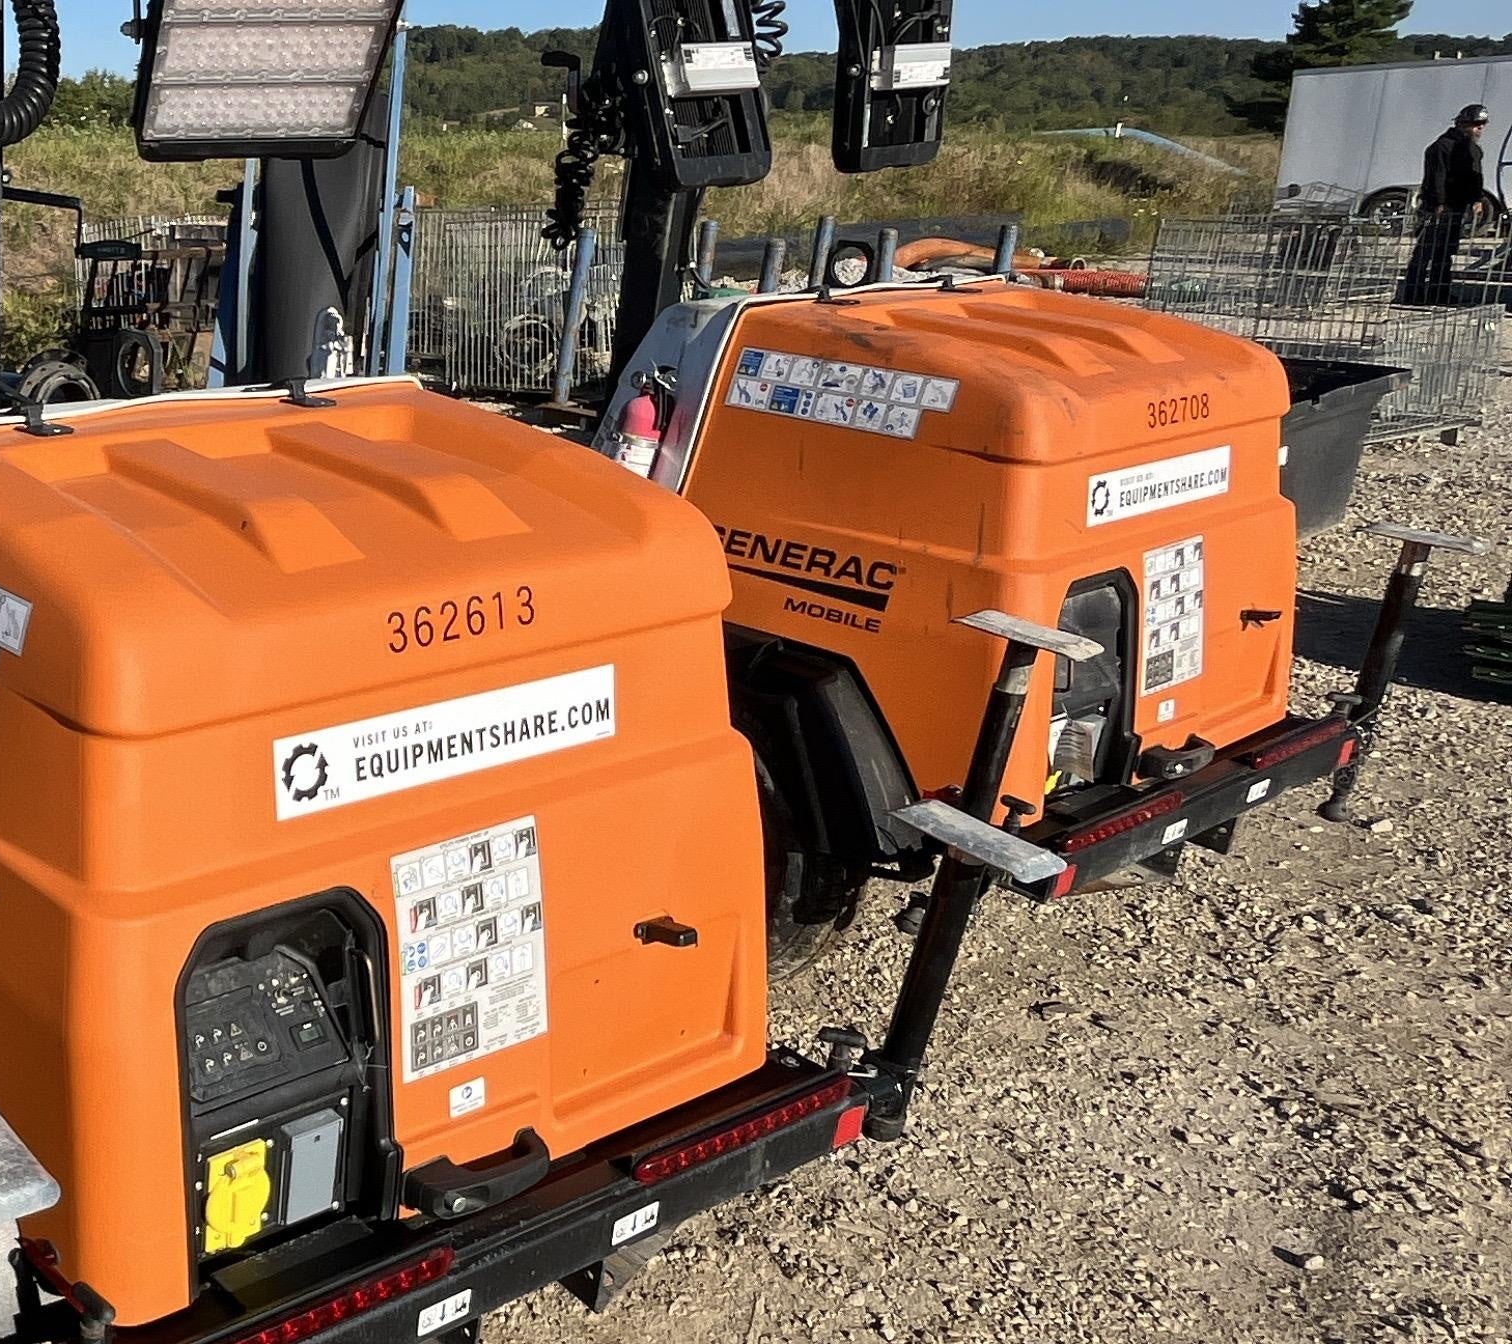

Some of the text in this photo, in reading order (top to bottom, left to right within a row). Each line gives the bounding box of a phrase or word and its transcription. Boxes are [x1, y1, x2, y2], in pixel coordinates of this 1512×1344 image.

[1148, 393, 1210, 429] 362708
[1119, 467, 1227, 508] EQUIPMENTSHARE.COM
[387, 585, 535, 653] 362613
[783, 596, 882, 634] MOBILE
[353, 730, 387, 749] VISIT
[393, 724, 408, 739] US
[355, 697, 611, 782] EQUIPMENTSHARE.COM
[323, 787, 340, 800] TM
